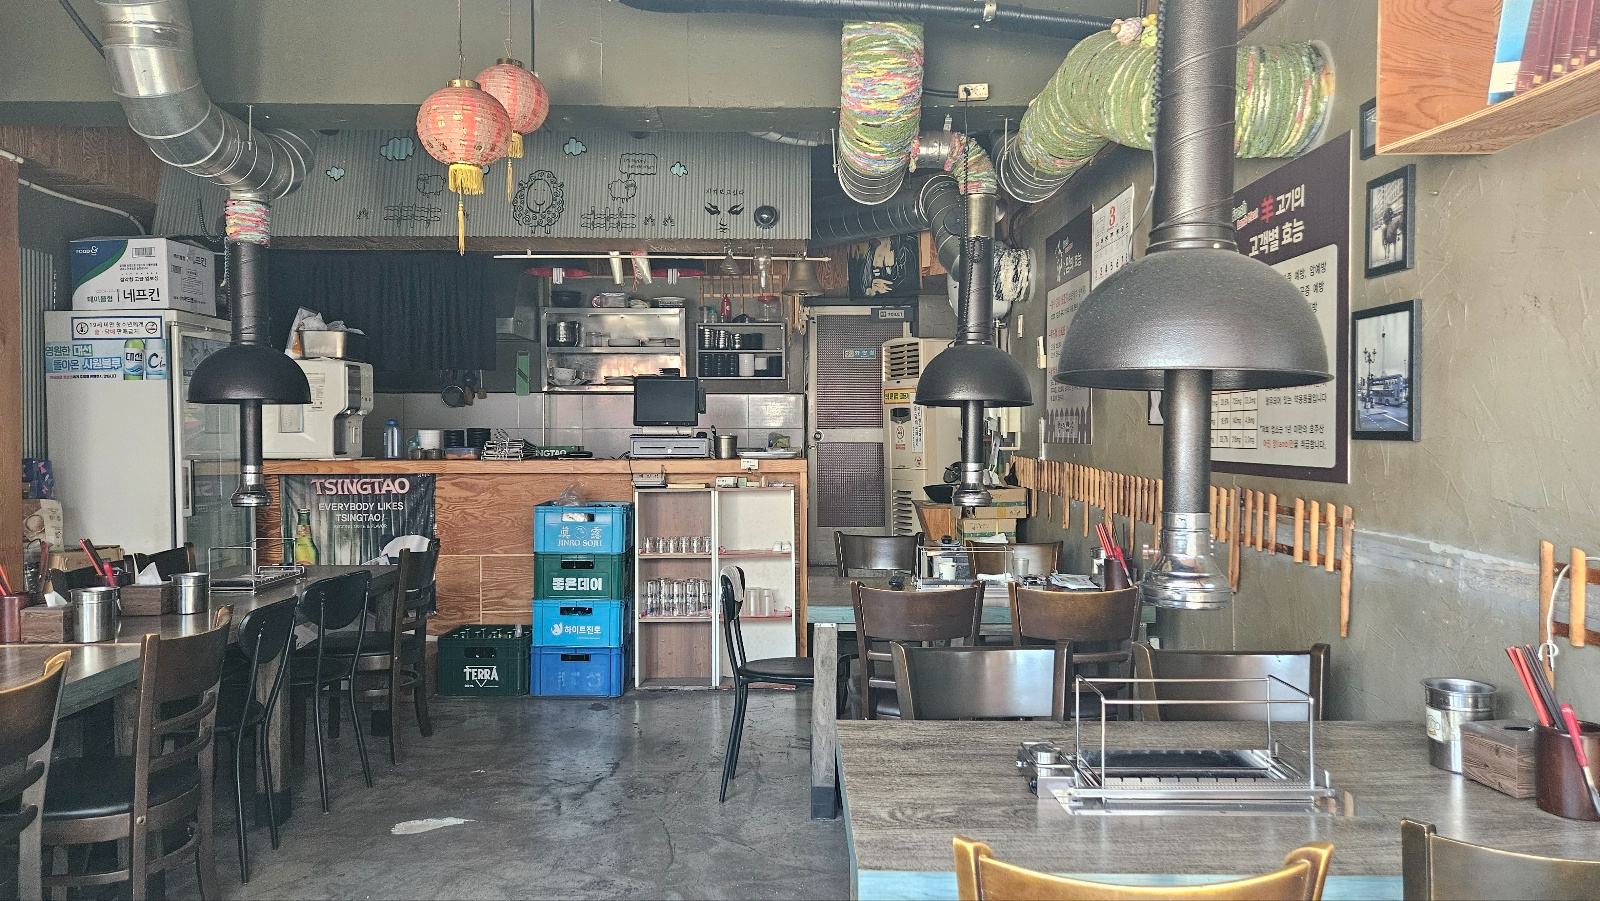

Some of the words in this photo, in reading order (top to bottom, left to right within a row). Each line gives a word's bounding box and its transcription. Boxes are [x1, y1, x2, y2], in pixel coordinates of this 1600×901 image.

[1110, 206, 1116, 226] 3
[1249, 226, 1279, 257] 고객별
[1281, 218, 1305, 245] 효능
[123, 288, 160, 302] 네프킨
[46, 346, 70, 356] 영원한
[74, 344, 92, 356] 대선
[53, 360, 80, 370] 돌아온
[82, 357, 122, 370] 시원블루
[126, 352, 142, 362] 대선
[311, 478, 410, 495] TSINGTAO
[318, 502, 374, 511] EVERYBODY
[378, 502, 404, 510] LIKES
[557, 540, 580, 548] JINRO
[582, 540, 602, 548] SOJU
[552, 578, 602, 591] 좋은데이
[564, 626, 602, 634] 하이트진로
[464, 668, 499, 681] TERRA
